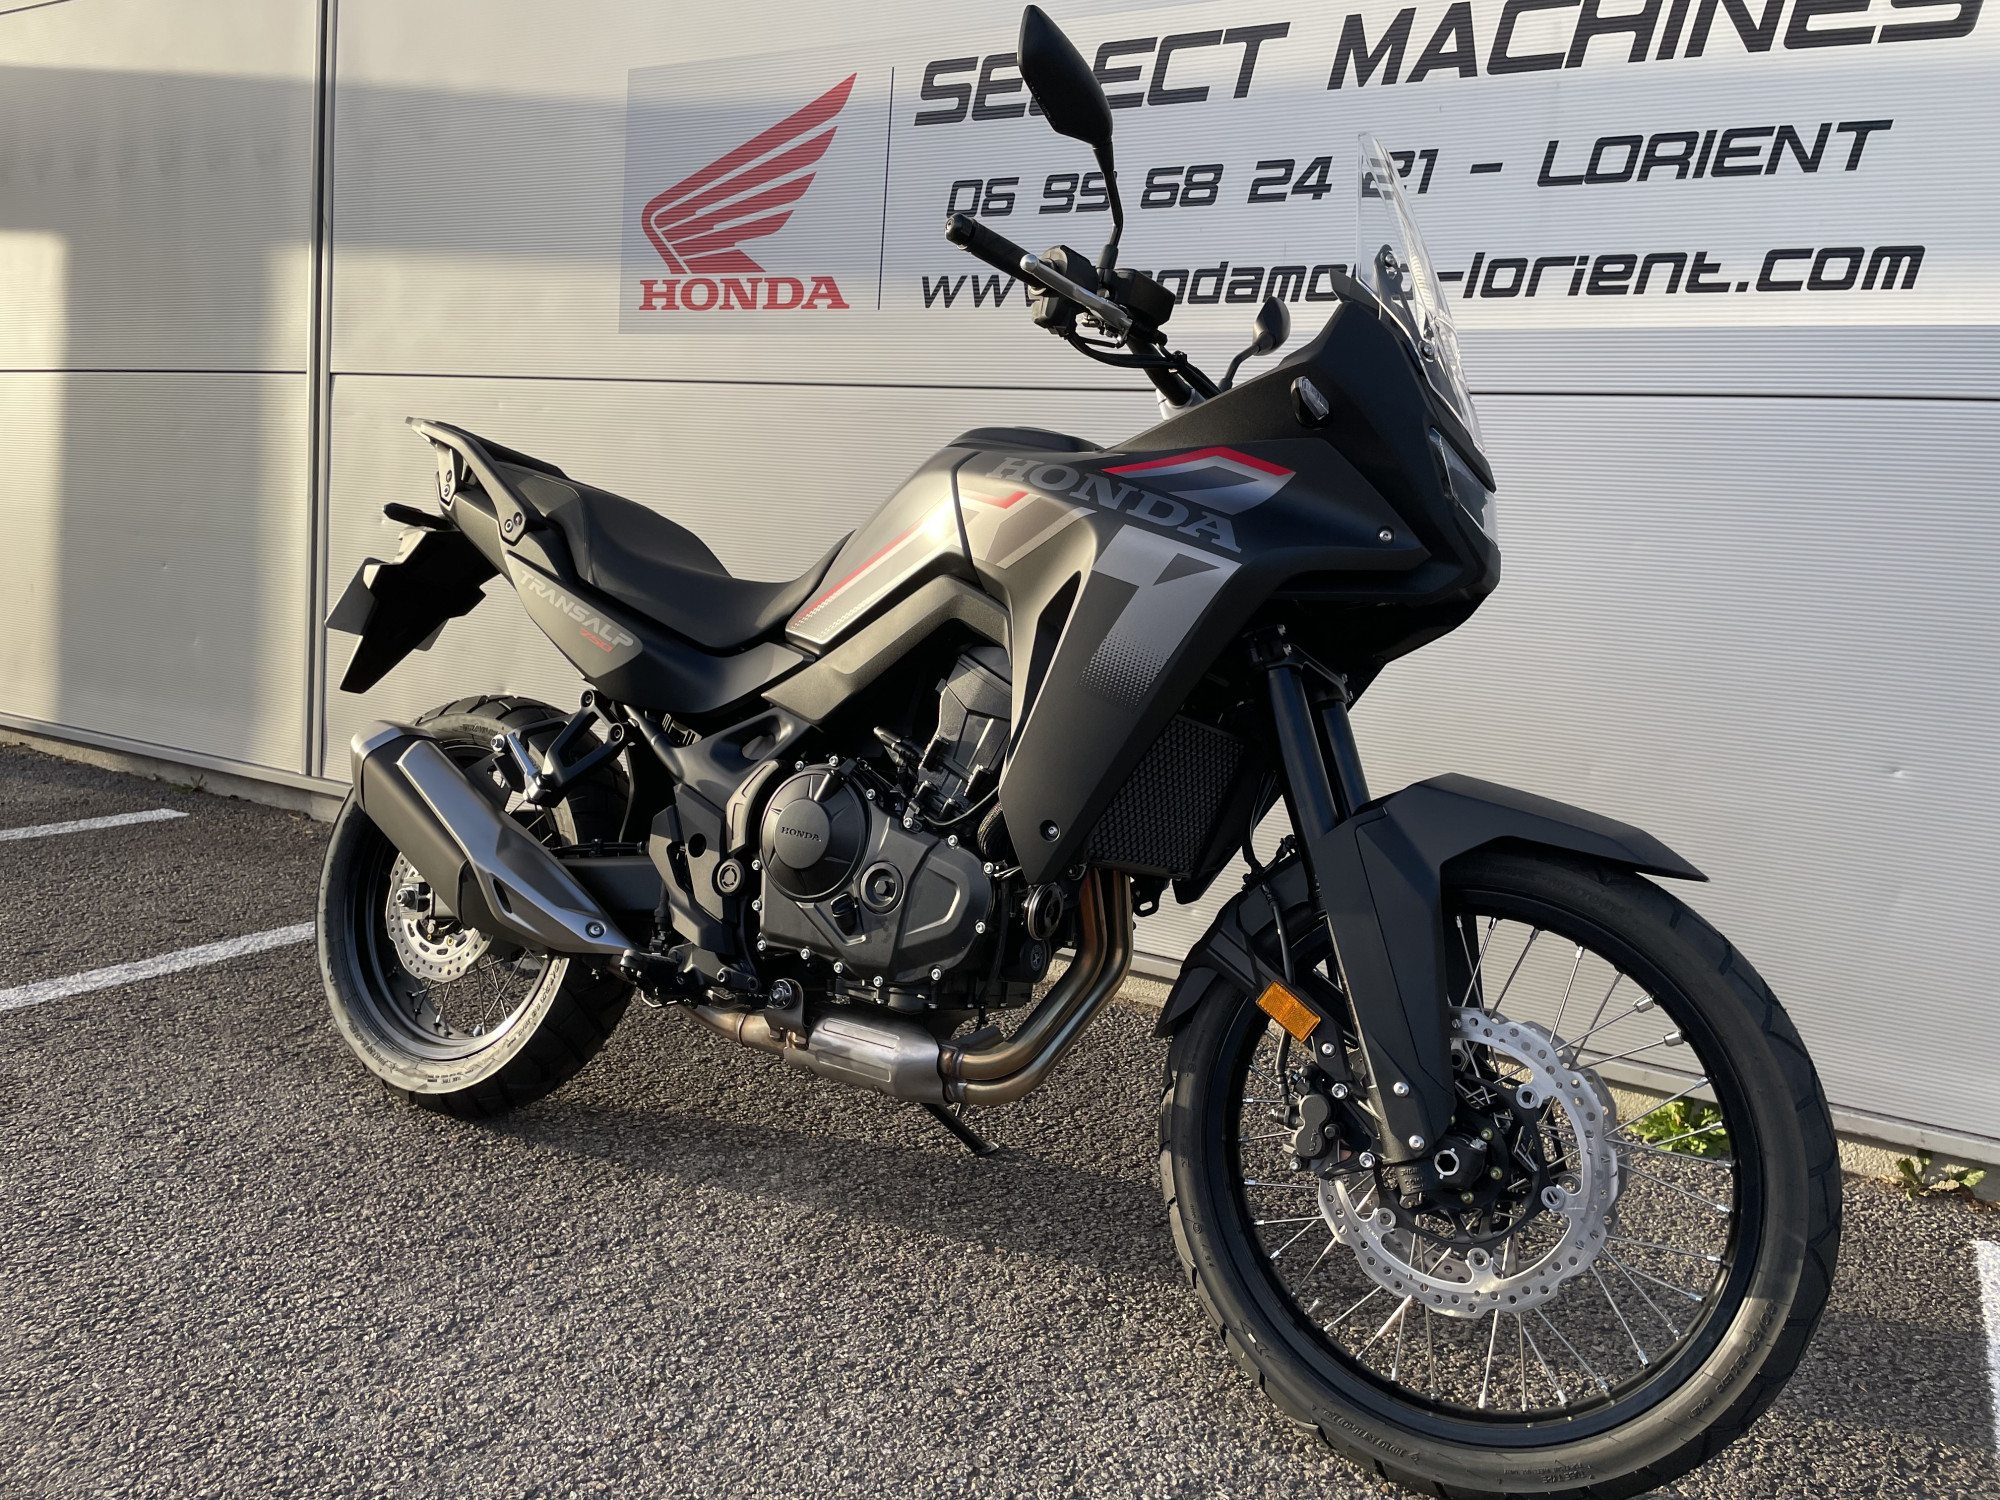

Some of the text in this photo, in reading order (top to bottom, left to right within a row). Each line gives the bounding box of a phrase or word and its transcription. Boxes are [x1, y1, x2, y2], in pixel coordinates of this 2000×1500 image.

[914, 22, 1291, 126] SEECT
[946, 176, 1019, 217] 06
[1140, 163, 1224, 209] 68
[1247, 155, 1333, 203] 24
[1537, 119, 1893, 187] LORIENT
[639, 276, 850, 310] HONDA
[985, 457, 1242, 553] HONDA
[519, 570, 634, 647] TRANSALP
[580, 628, 613, 653] 750
[781, 826, 822, 842] HONDA
